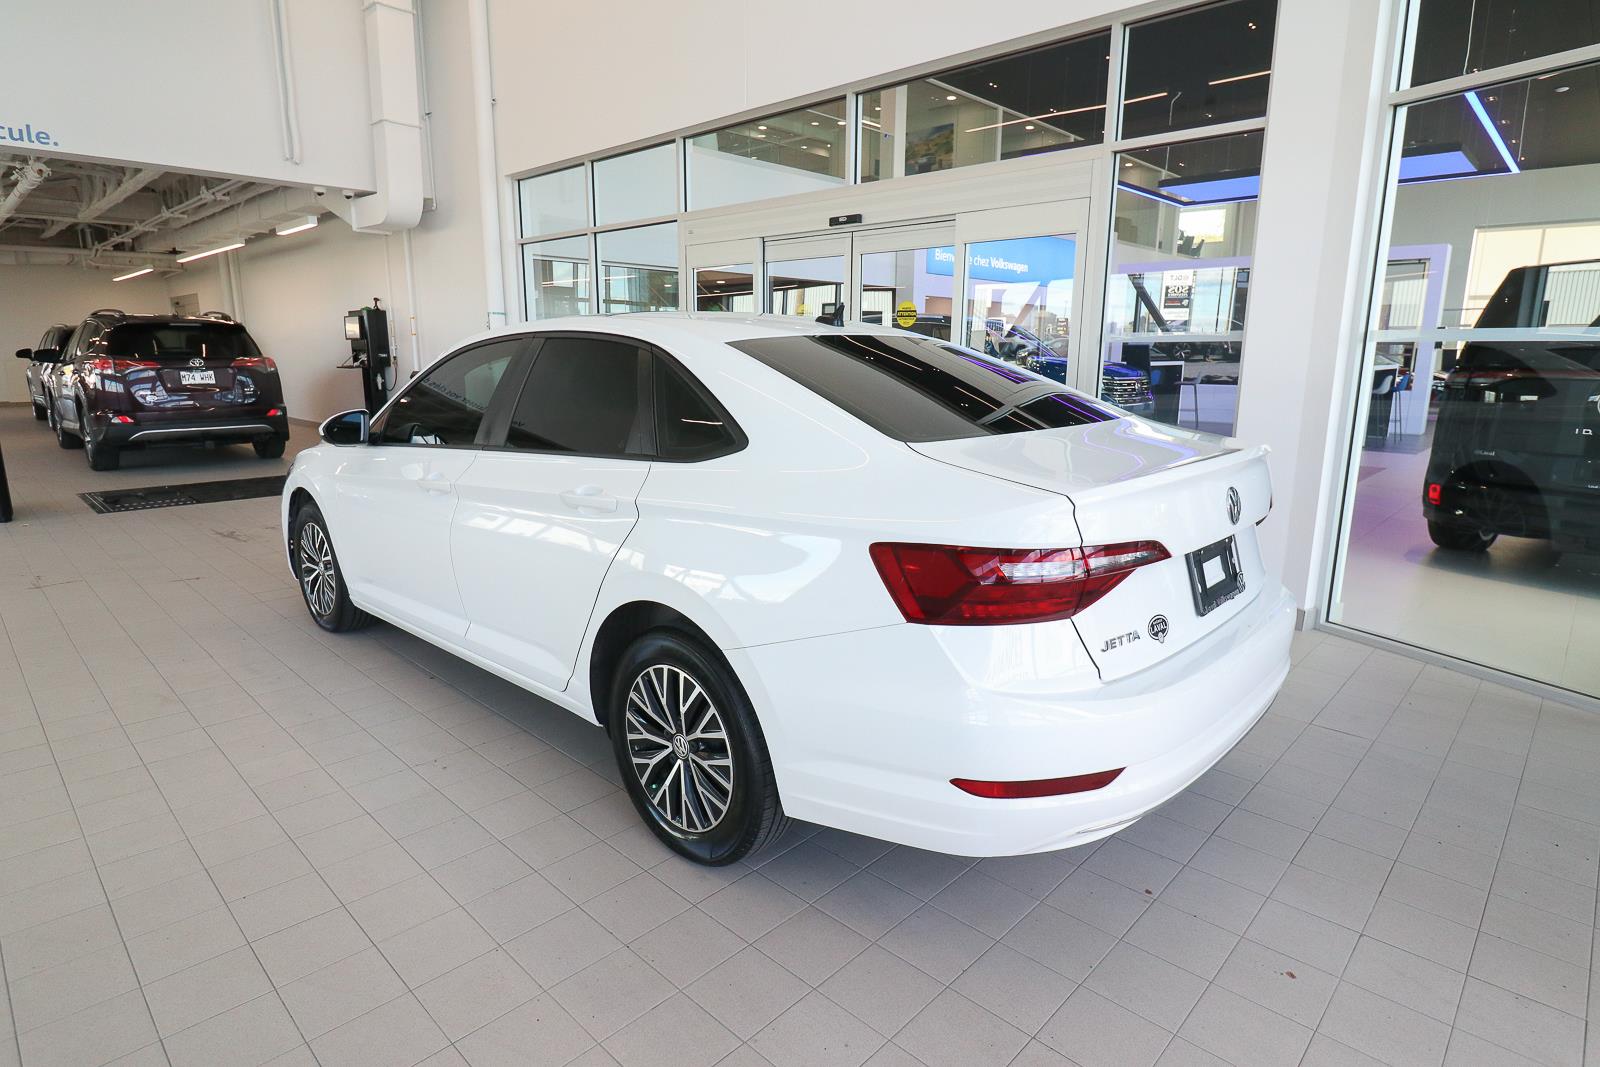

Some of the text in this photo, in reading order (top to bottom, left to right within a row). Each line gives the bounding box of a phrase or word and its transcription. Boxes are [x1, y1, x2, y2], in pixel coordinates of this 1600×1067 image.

[973, 254, 989, 267] chez
[990, 256, 1029, 274] Volkswagen
[1150, 621, 1167, 634] LAVAL
[1100, 630, 1141, 652] JETTA
